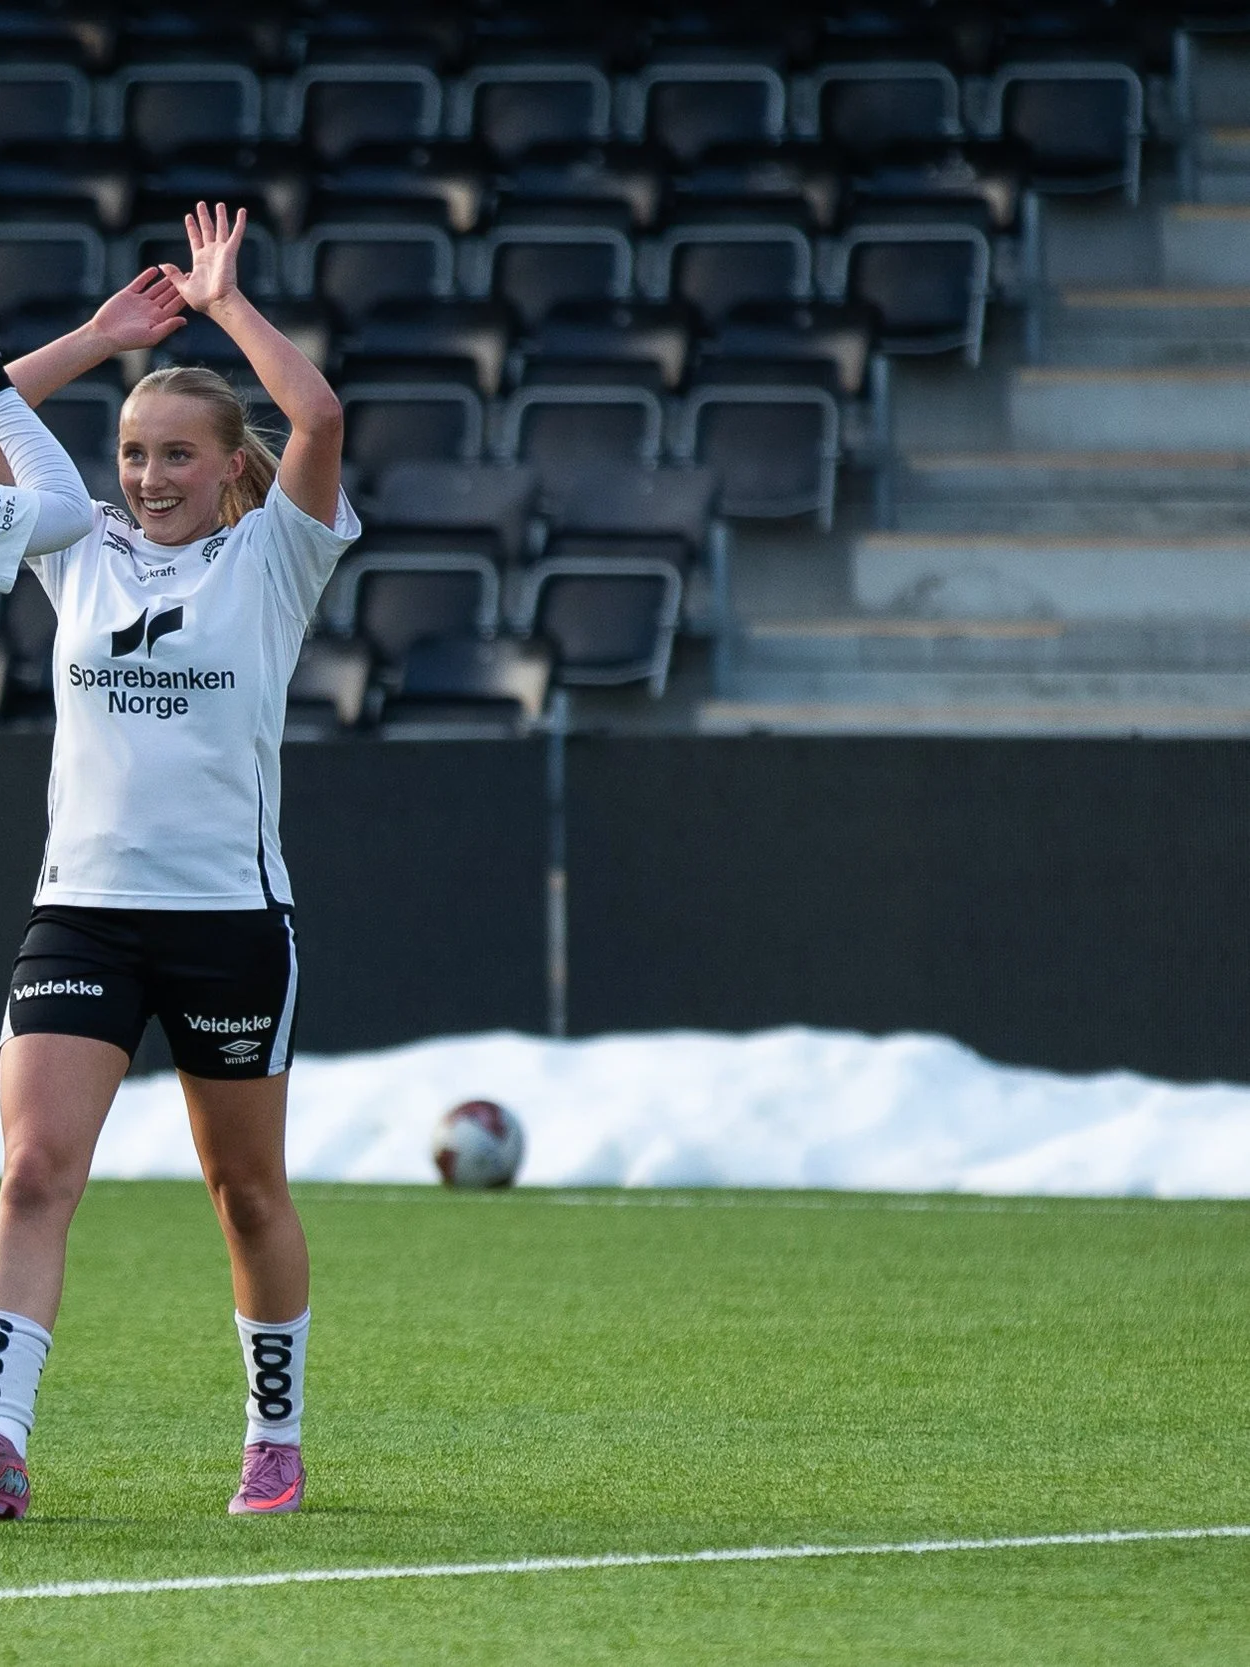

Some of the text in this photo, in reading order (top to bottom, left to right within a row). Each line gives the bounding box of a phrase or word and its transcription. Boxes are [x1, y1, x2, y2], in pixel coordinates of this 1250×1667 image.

[68, 663, 236, 692] Sparebanken
[108, 690, 190, 720] Norge
[14, 979, 104, 1001] Veidekke
[184, 1012, 273, 1034] Veidekke
[224, 1053, 259, 1065] umbro
